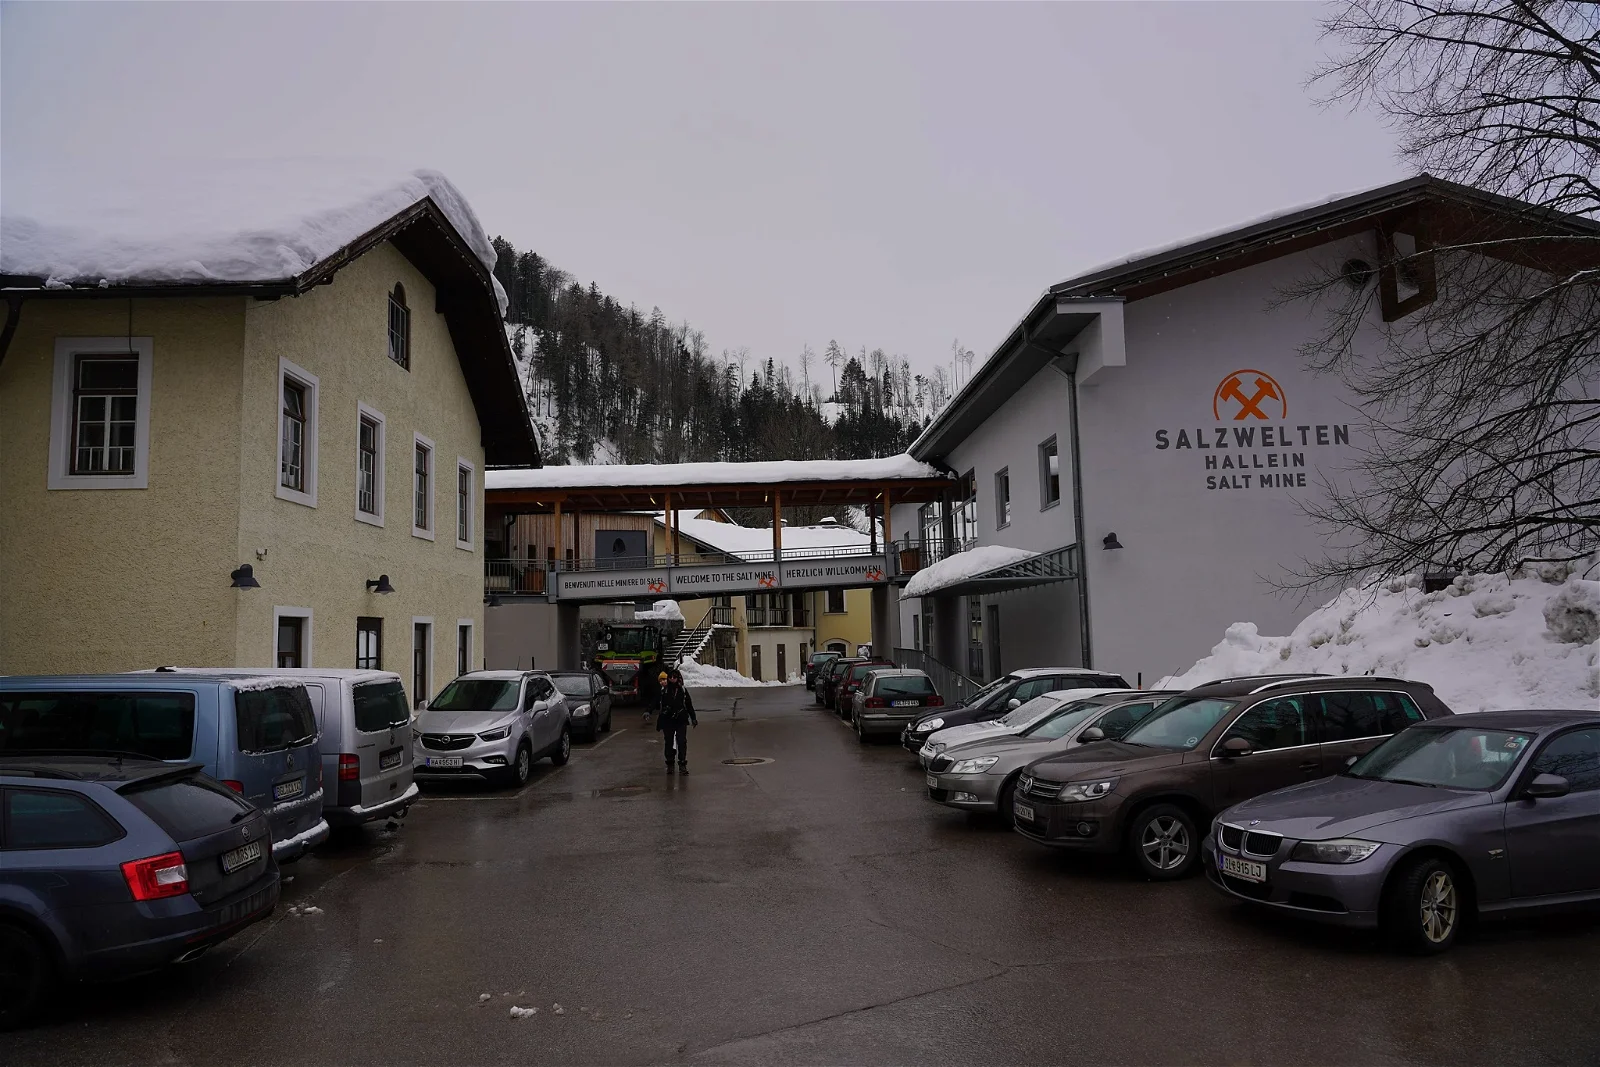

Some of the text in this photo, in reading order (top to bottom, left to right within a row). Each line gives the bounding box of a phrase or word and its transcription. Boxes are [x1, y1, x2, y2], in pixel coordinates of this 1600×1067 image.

[1155, 424, 1350, 450] SALZWELTEN
[1205, 452, 1305, 470] HALLEIN
[1206, 472, 1307, 490] SALT MINE
[675, 573, 710, 584] WELCOME
[711, 573, 720, 582] TO
[722, 572, 735, 582] THE
[736, 571, 753, 581] SALT
[786, 564, 881, 578] HERZLICH WILLKOMMEN!
[564, 580, 596, 589] BENVENUTI
[597, 579, 614, 588] NELLE
[615, 578, 639, 587] MINIERE
[639, 578, 646, 586] DI
